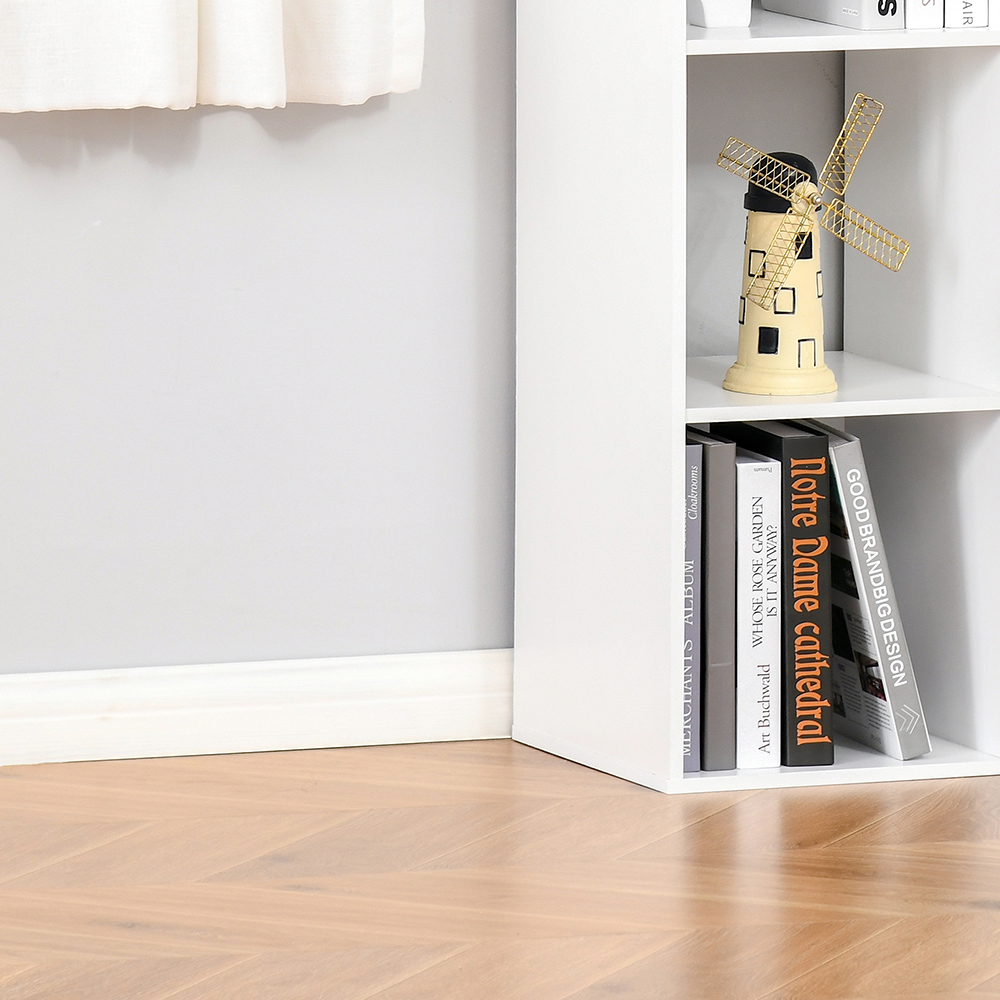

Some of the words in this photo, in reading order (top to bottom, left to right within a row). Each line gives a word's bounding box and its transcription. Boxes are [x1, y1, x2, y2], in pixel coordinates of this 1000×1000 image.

[687, 465, 699, 521] Cloakrooms
[752, 496, 763, 554] GARDEN
[752, 558, 763, 592] ROSE
[766, 524, 778, 584] ANYWAY?
[791, 536, 829, 613] Dame
[684, 558, 695, 626] ALBUM
[766, 588, 778, 602] IT
[766, 606, 778, 618] IS
[752, 596, 763, 648] WHOSE
[757, 663, 771, 729] Buchwald
[793, 621, 830, 746] cathedral
[757, 732, 771, 754] Art
